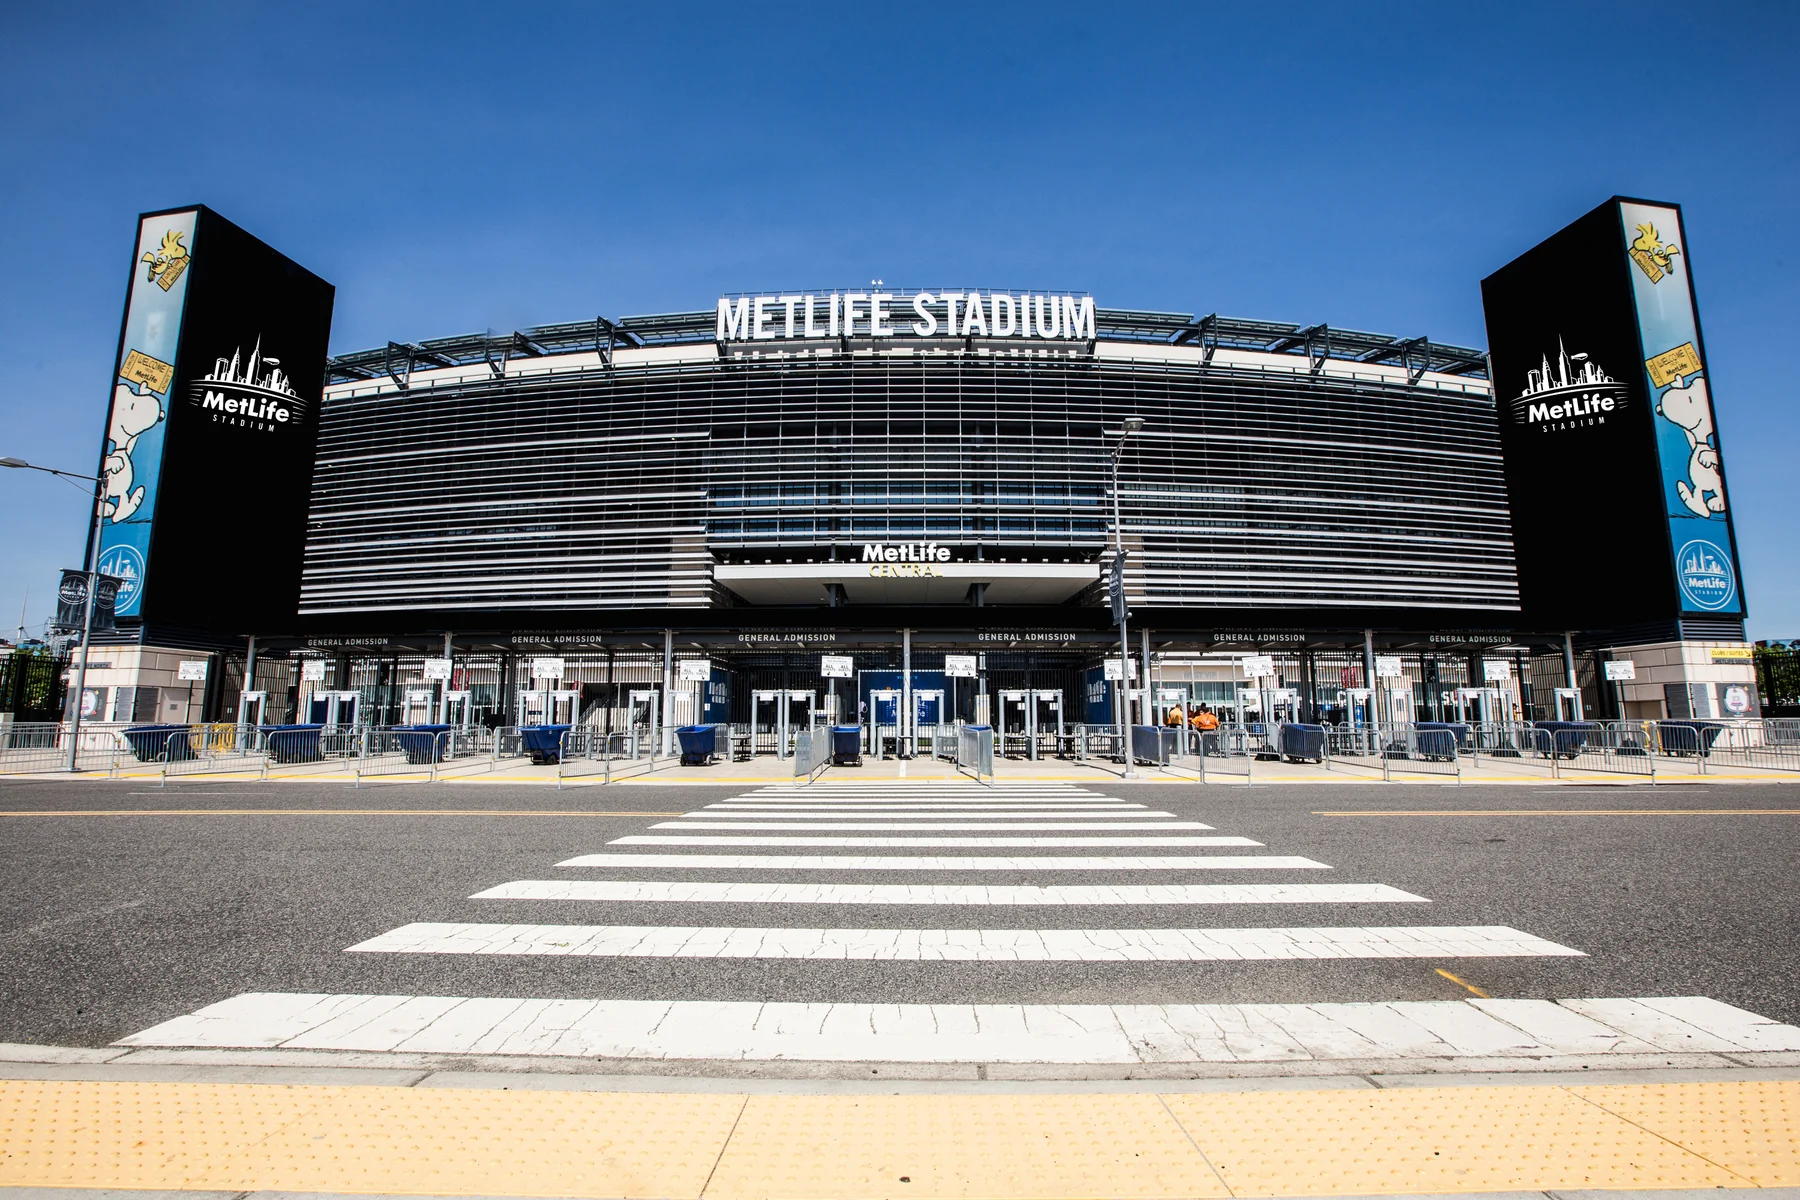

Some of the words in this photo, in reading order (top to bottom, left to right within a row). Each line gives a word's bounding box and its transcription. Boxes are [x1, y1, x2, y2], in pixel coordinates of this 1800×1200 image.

[716, 294, 894, 341] METLIFE
[912, 292, 1096, 340] STADIUM
[137, 356, 167, 374] WELCOME
[1656, 349, 1686, 368] WELCOME
[134, 370, 158, 384] MetLife
[1666, 362, 1688, 377] MetLife
[202, 390, 290, 422] MetLife
[1528, 393, 1615, 423] MetLife
[212, 414, 275, 432] STADIUM
[1542, 416, 1605, 432] STADIUM
[862, 542, 951, 562] MetLife
[869, 564, 943, 578] CENTRAL
[1688, 577, 1726, 589] MetLife
